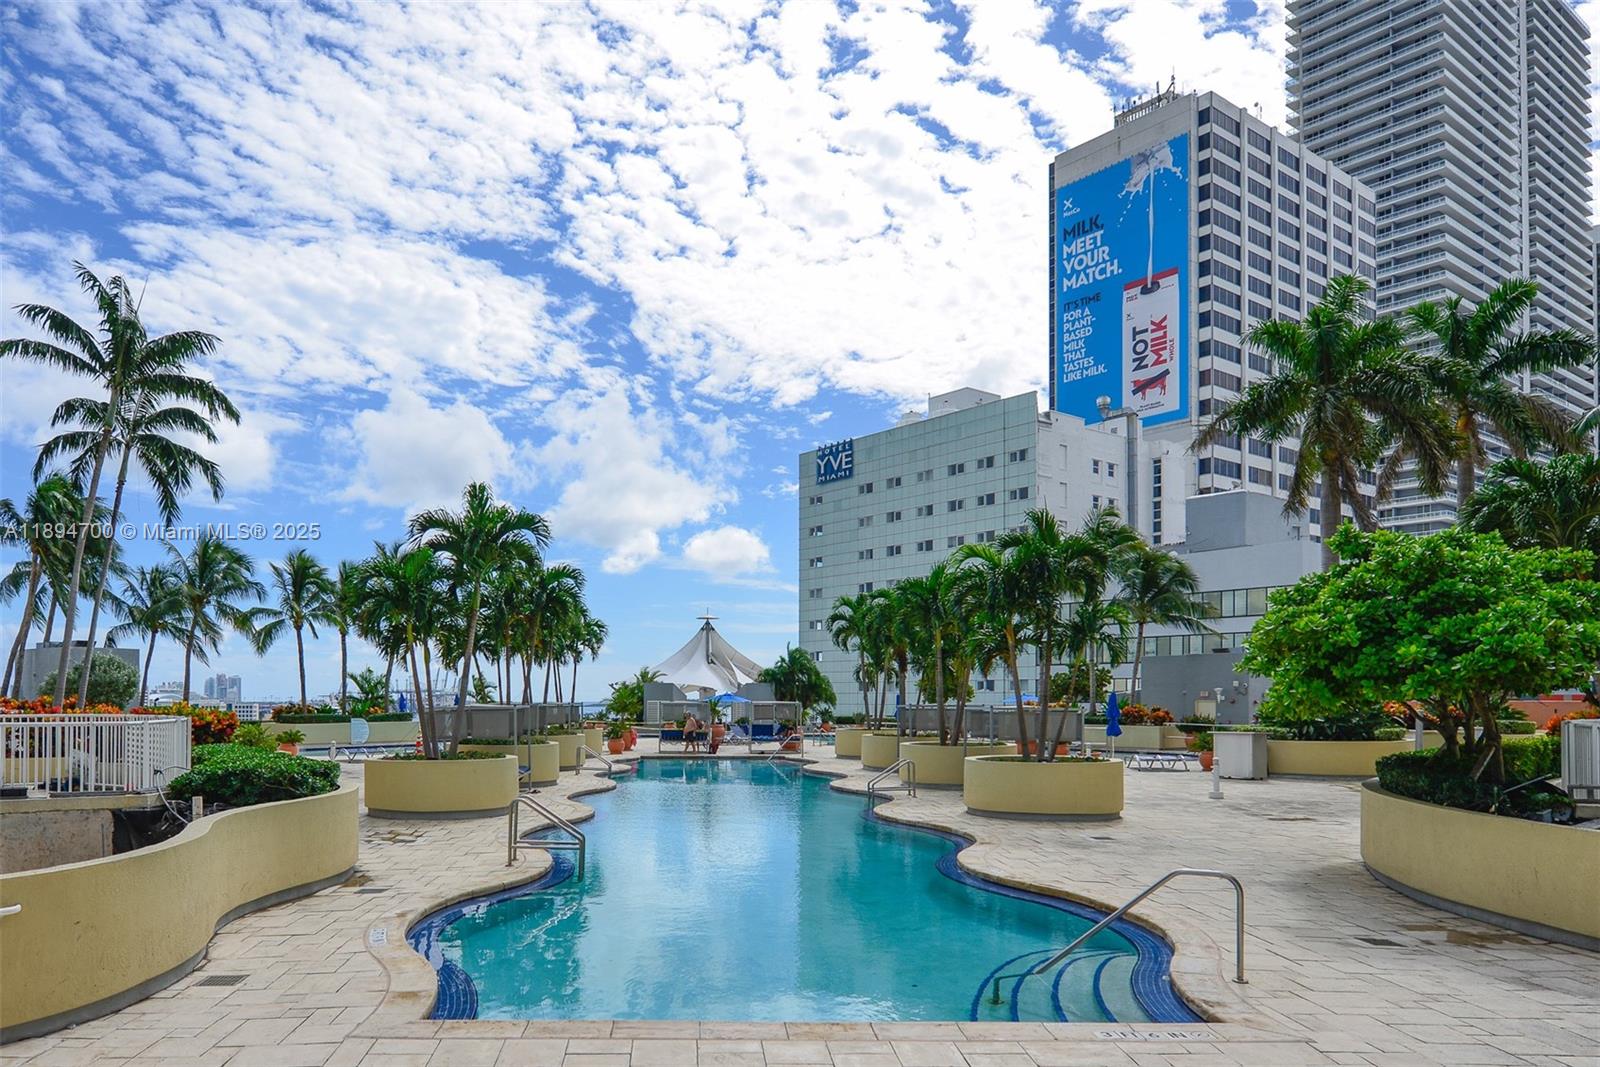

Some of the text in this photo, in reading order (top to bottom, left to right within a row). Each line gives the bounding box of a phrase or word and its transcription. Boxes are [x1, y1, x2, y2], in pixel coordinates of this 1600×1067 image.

[1063, 214, 1104, 242] MILK,
[1062, 229, 1104, 259] MEET
[1062, 246, 1110, 274] YOUR
[1062, 258, 1122, 292] MATCH.
[1080, 291, 1102, 307] TIME
[1063, 306, 1091, 322] FOR A
[1063, 315, 1096, 333] PLANT-
[1063, 326, 1093, 343] BASED
[1150, 314, 1168, 368] MILK
[1063, 338, 1085, 353] MILK
[1131, 326, 1149, 372] NOT
[1063, 348, 1086, 363] THAT
[1063, 356, 1094, 373] TASTES
[1063, 364, 1108, 383] LIKE MILK.
[817, 444, 850, 456] HOTEL
[817, 451, 852, 474] YVE
[819, 470, 849, 482] MIAMI
